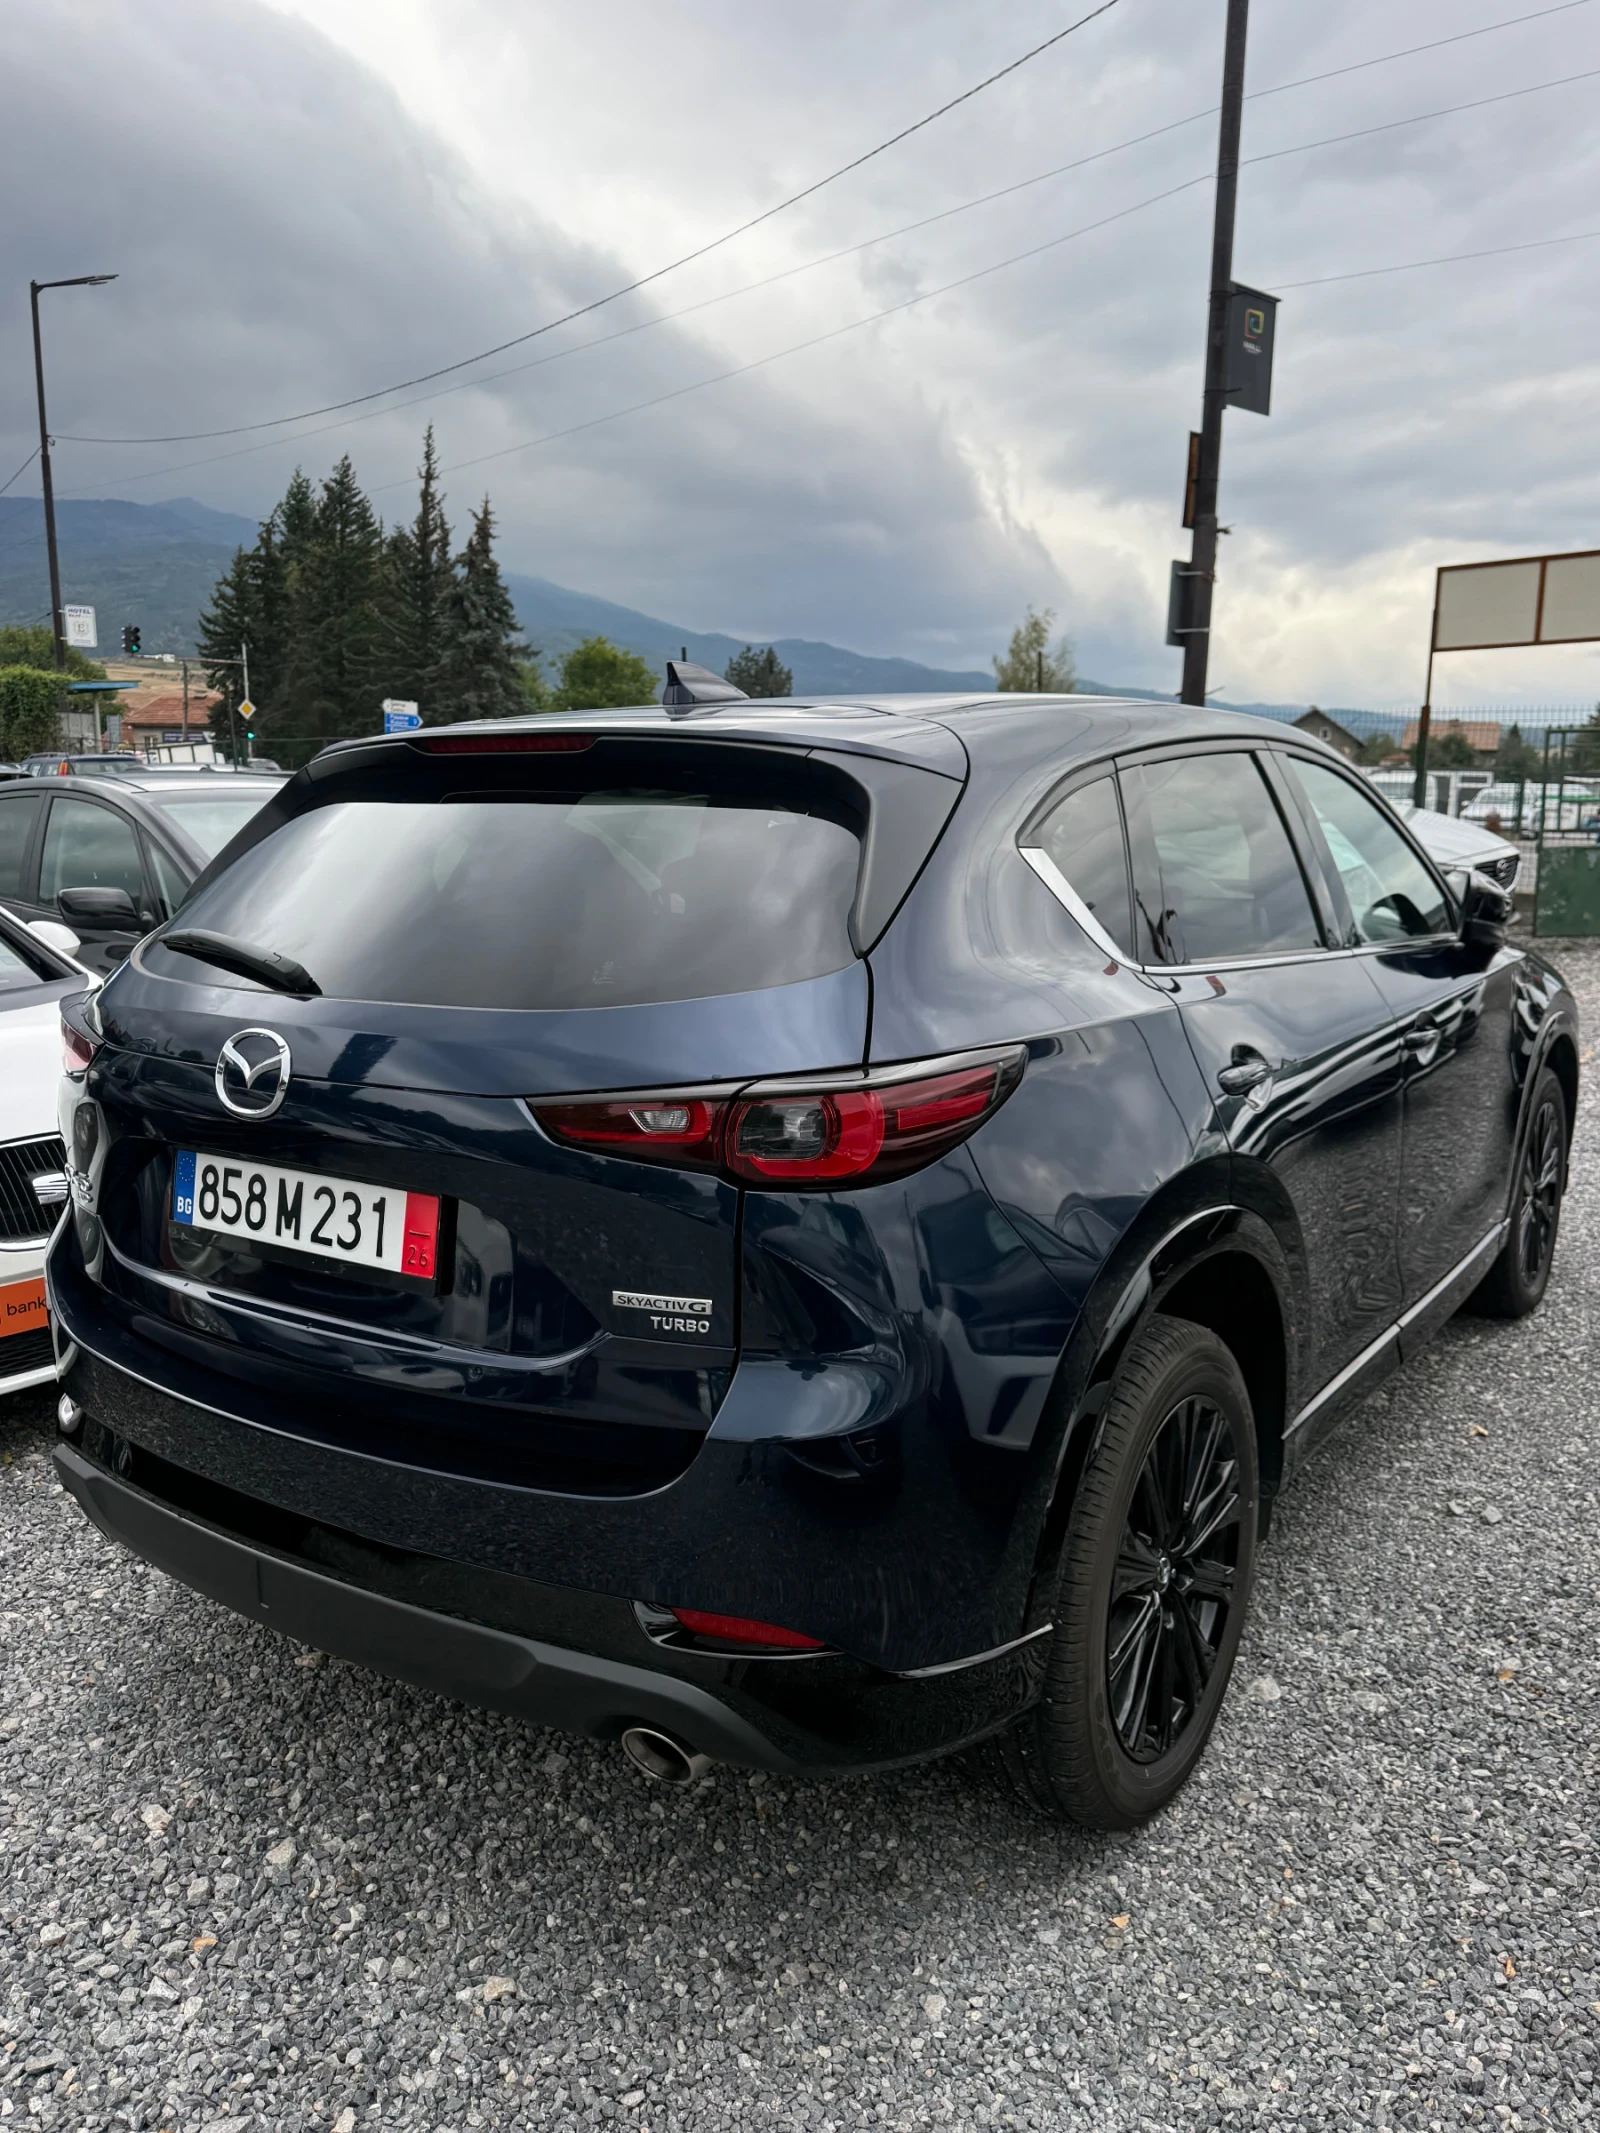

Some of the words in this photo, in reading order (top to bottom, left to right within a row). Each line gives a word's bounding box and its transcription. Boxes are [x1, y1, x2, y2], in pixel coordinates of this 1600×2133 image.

[176, 1195, 192, 1215] BG
[407, 1246, 429, 1268] 26
[6, 1296, 47, 1317] bank
[650, 1316, 710, 1333] TURBO
